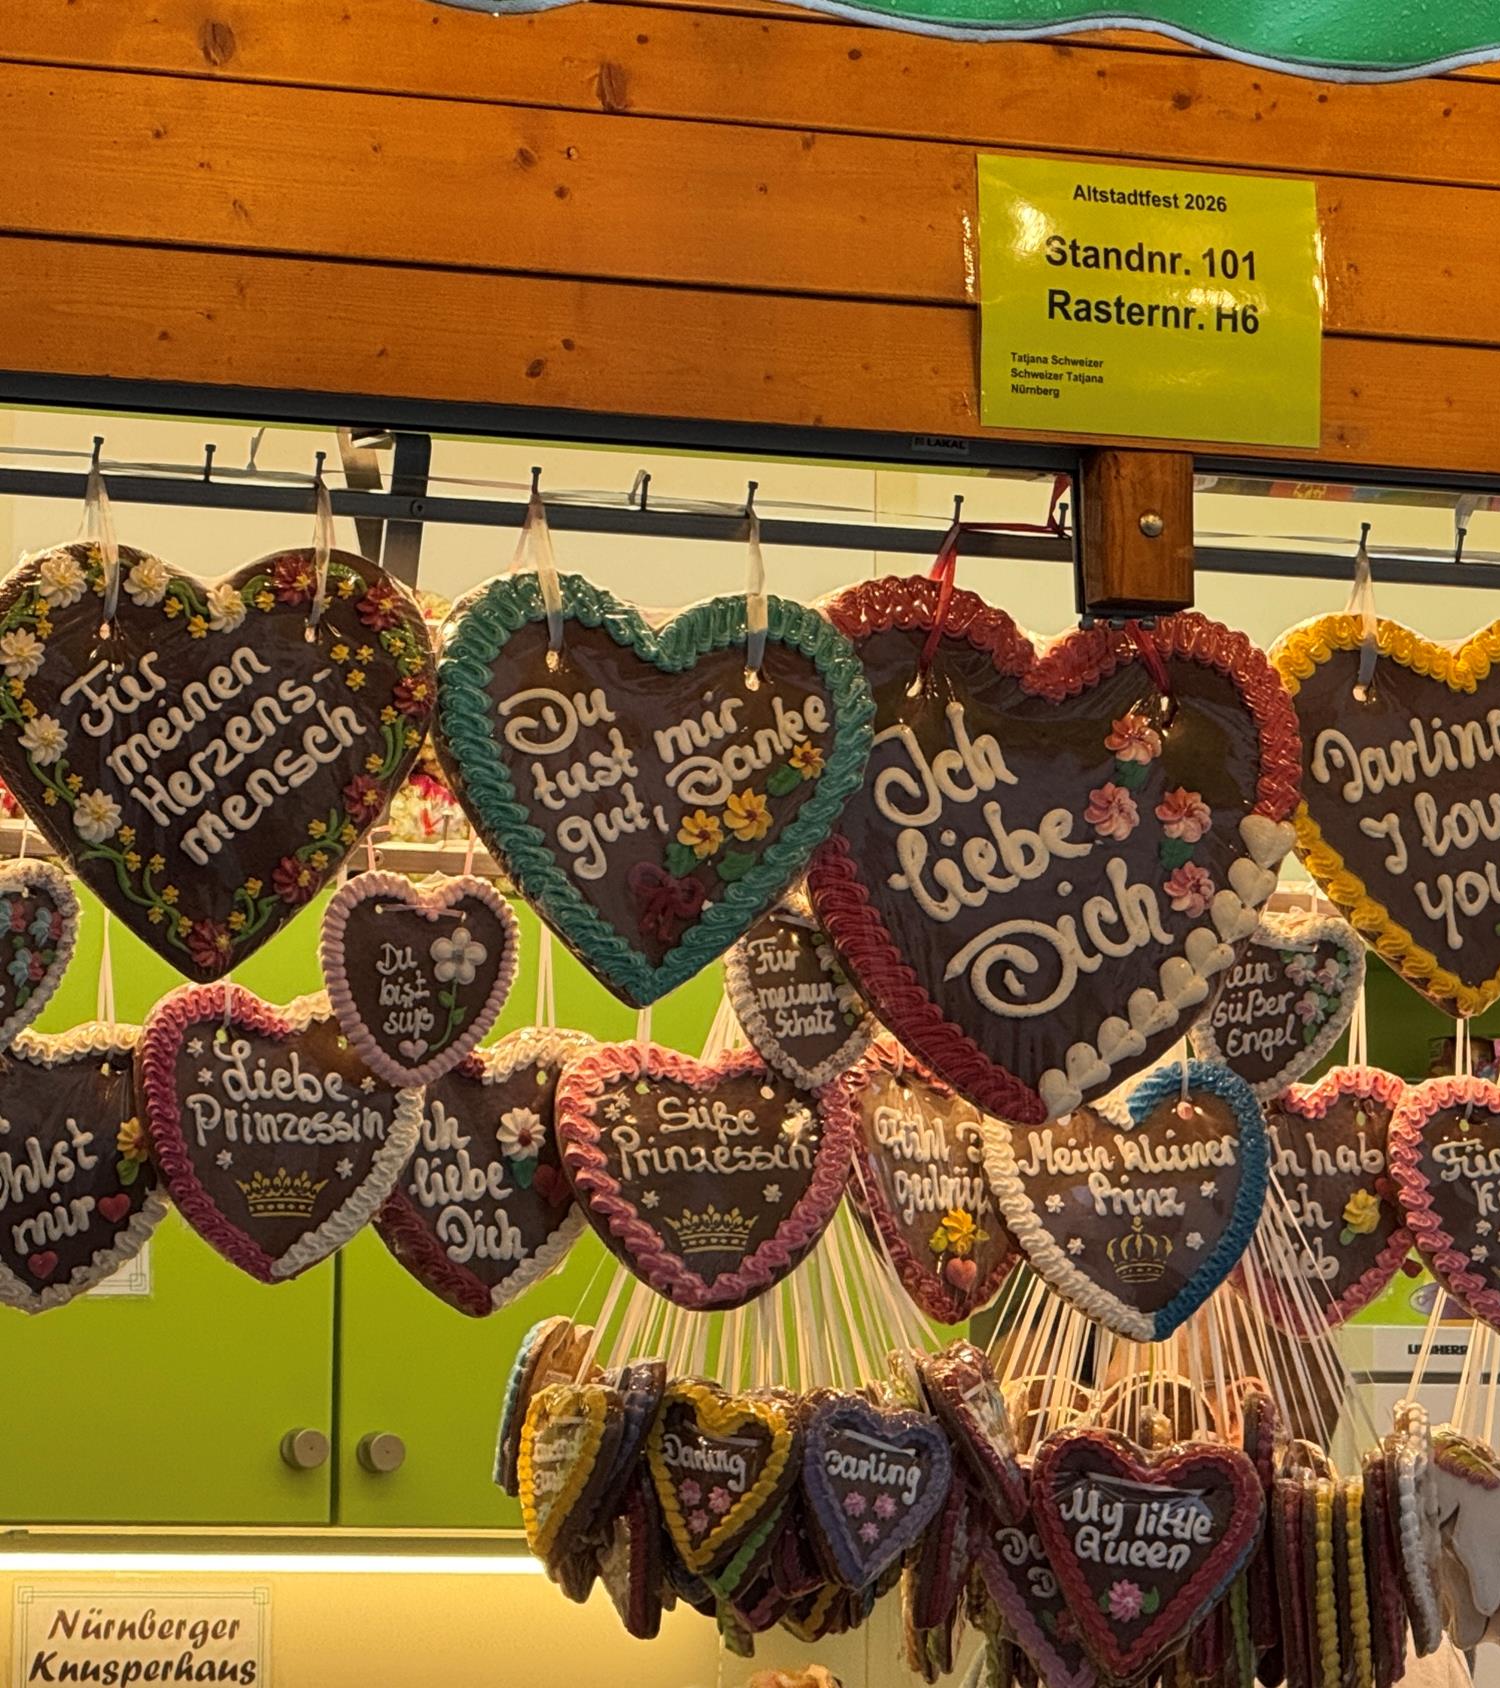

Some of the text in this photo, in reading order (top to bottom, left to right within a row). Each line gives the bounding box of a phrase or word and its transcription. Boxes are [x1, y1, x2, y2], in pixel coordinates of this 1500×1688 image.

[1072, 184, 1228, 213] Altstadtfest 2026
[1045, 235, 1257, 281] Standnr. 101
[1048, 288, 1260, 335] Rasternr. H6
[1010, 352, 1104, 369] Tatjana Schweizer
[1010, 368, 1104, 385] Schweizer Tatjana
[1010, 383, 1060, 399] Nürnberg
[60, 651, 166, 737] Für
[106, 647, 271, 785] meinen
[498, 688, 615, 754] Du
[130, 668, 333, 827] Herzens-
[531, 690, 743, 810] tust mir
[872, 702, 1018, 826] Ich
[180, 700, 367, 866] mensch
[557, 695, 830, 880] gut, Danke
[887, 800, 1093, 922] liebe
[376, 943, 417, 975] Du
[748, 936, 800, 975] Für
[943, 857, 1174, 1018] Dich
[379, 970, 430, 1006] bist
[1226, 951, 1275, 989] ein
[775, 1005, 836, 1039] Schatz
[1212, 989, 1295, 1028] süßer
[1226, 1014, 1297, 1062] Engel
[213, 1040, 349, 1103] Liebe
[186, 1094, 385, 1147] Prinzessin
[422, 1100, 471, 1152] ch
[657, 1097, 759, 1144] Süße
[0, 1118, 98, 1208] hlst
[408, 1149, 513, 1208] liebe
[611, 1125, 812, 1181] Prinzessin
[1017, 1129, 1114, 1176] Mein
[1305, 1132, 1386, 1176] hab
[1088, 1171, 1186, 1217] Prinz
[12, 1195, 95, 1255] mir
[436, 1205, 528, 1264] Dich
[663, 1434, 747, 1493] Darling
[824, 1450, 922, 1506] Darling
[1059, 1487, 1214, 1544] My little
[1073, 1525, 1192, 1573] Queen
[48, 1607, 241, 1649] Nürnberger
[28, 1650, 257, 1688] Knusperhaus
